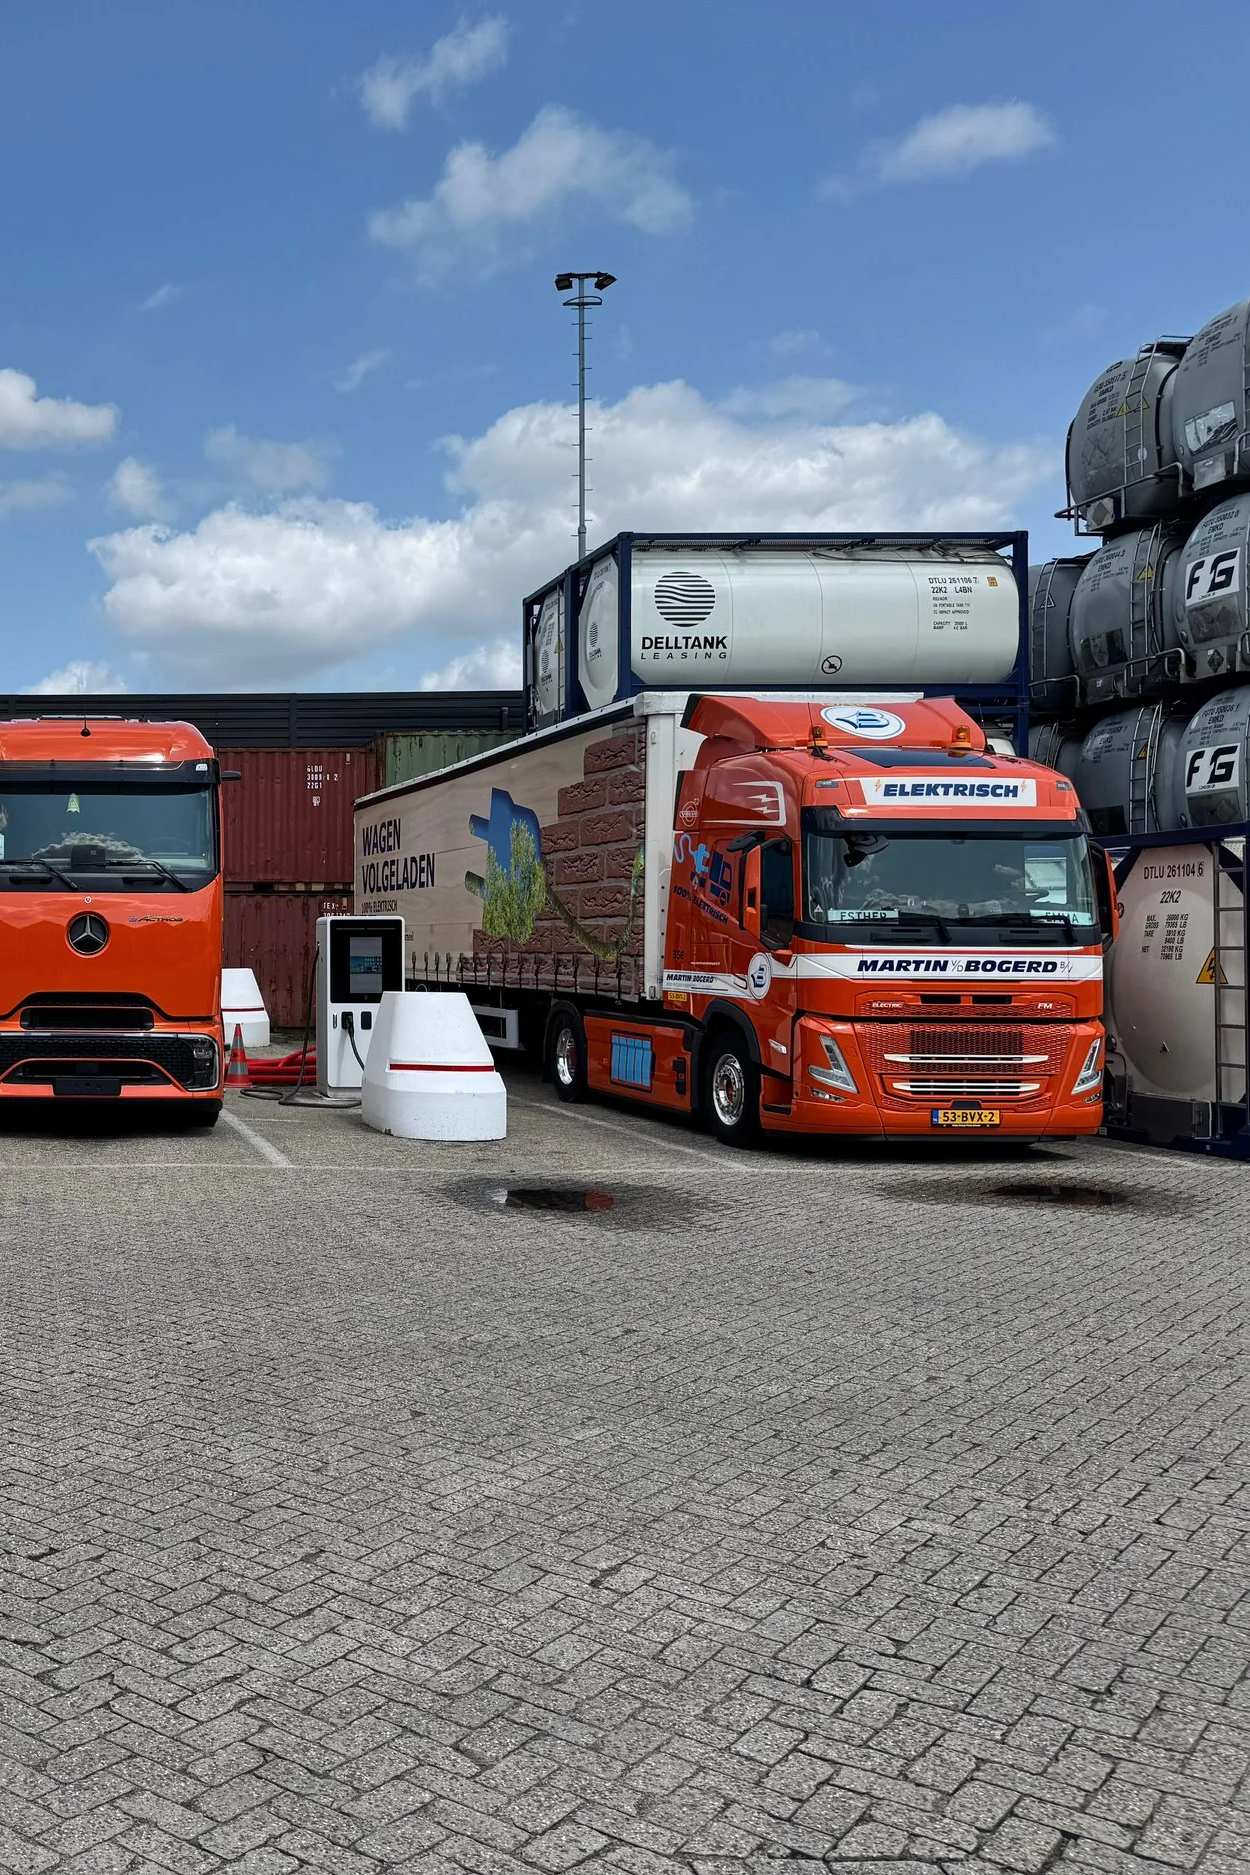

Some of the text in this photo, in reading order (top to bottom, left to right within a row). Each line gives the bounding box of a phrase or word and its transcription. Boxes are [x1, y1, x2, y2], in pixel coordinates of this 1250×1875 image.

[642, 636, 727, 649] DELLTANK
[1186, 745, 1238, 787] FG
[883, 783, 1018, 798] ELEKTRISCH
[363, 818, 401, 856] WAGEN
[362, 853, 435, 894] VOLGELADEN
[1144, 865, 1164, 879] DTLU
[1167, 863, 1195, 878] 261104
[1160, 891, 1181, 904] 22K2
[857, 960, 949, 972] MARTIN
[964, 960, 1058, 973] BOGERD
[943, 1112, 994, 1122] 53-BVX-2
